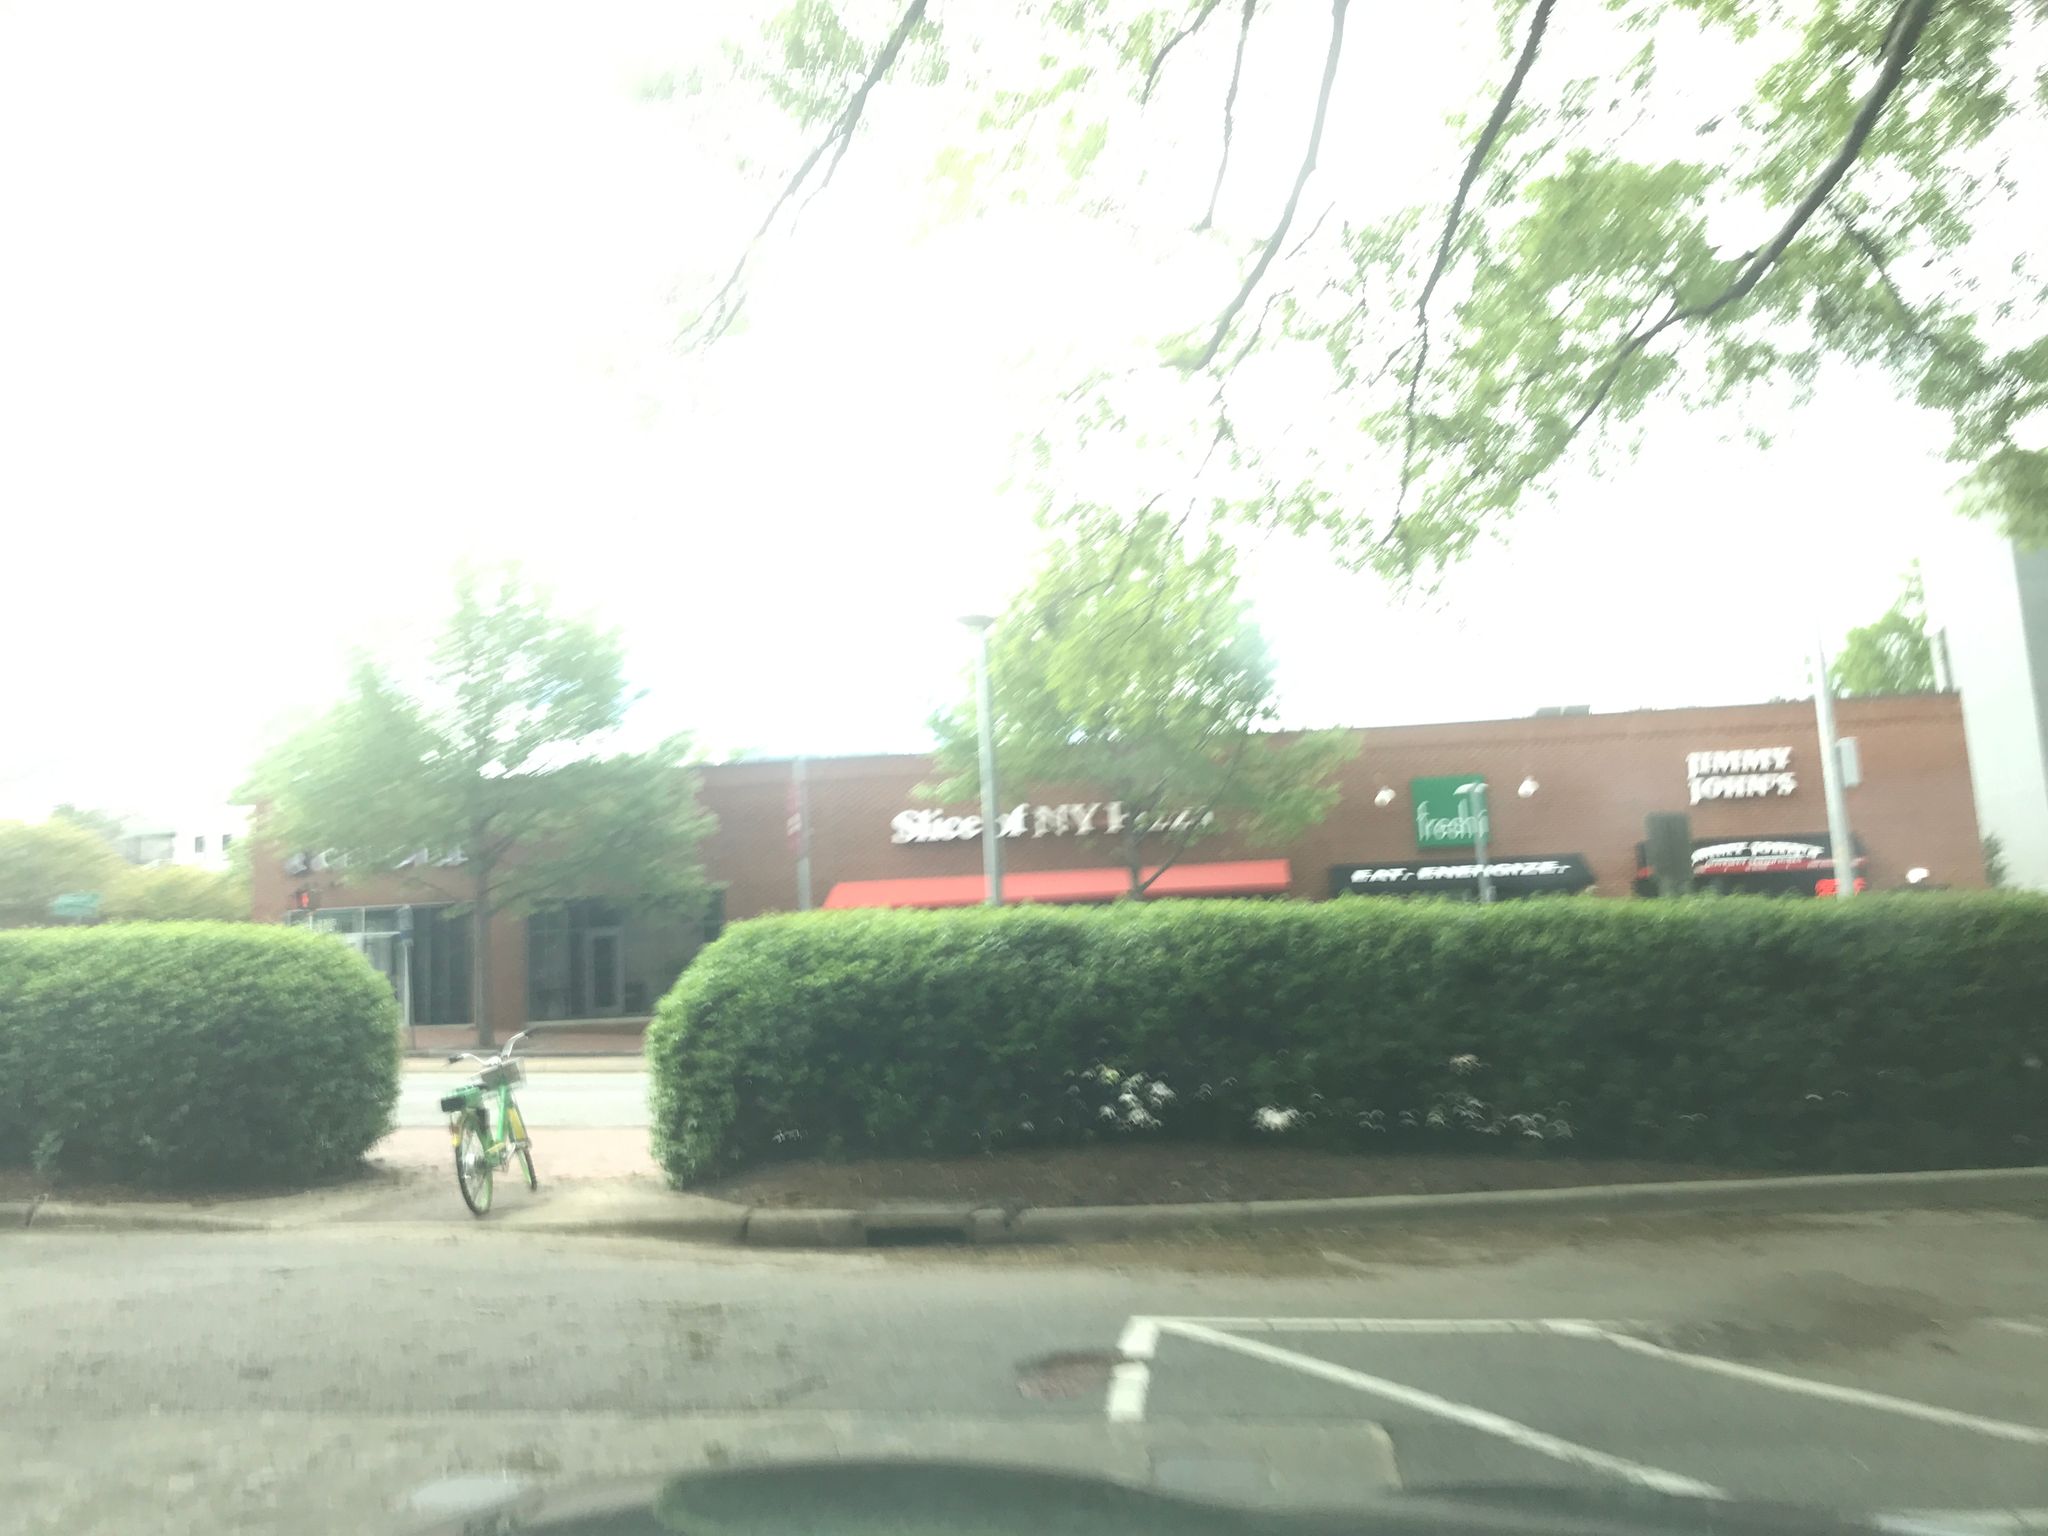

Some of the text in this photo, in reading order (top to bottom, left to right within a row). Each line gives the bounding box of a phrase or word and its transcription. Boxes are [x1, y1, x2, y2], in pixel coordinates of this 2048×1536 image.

[1686, 747, 1792, 779] JIMMY
[1688, 773, 1798, 805] JOHN'S
[891, 808, 984, 844] Slice
[1031, 802, 1101, 838] NY
[1416, 800, 1487, 841] freshi
